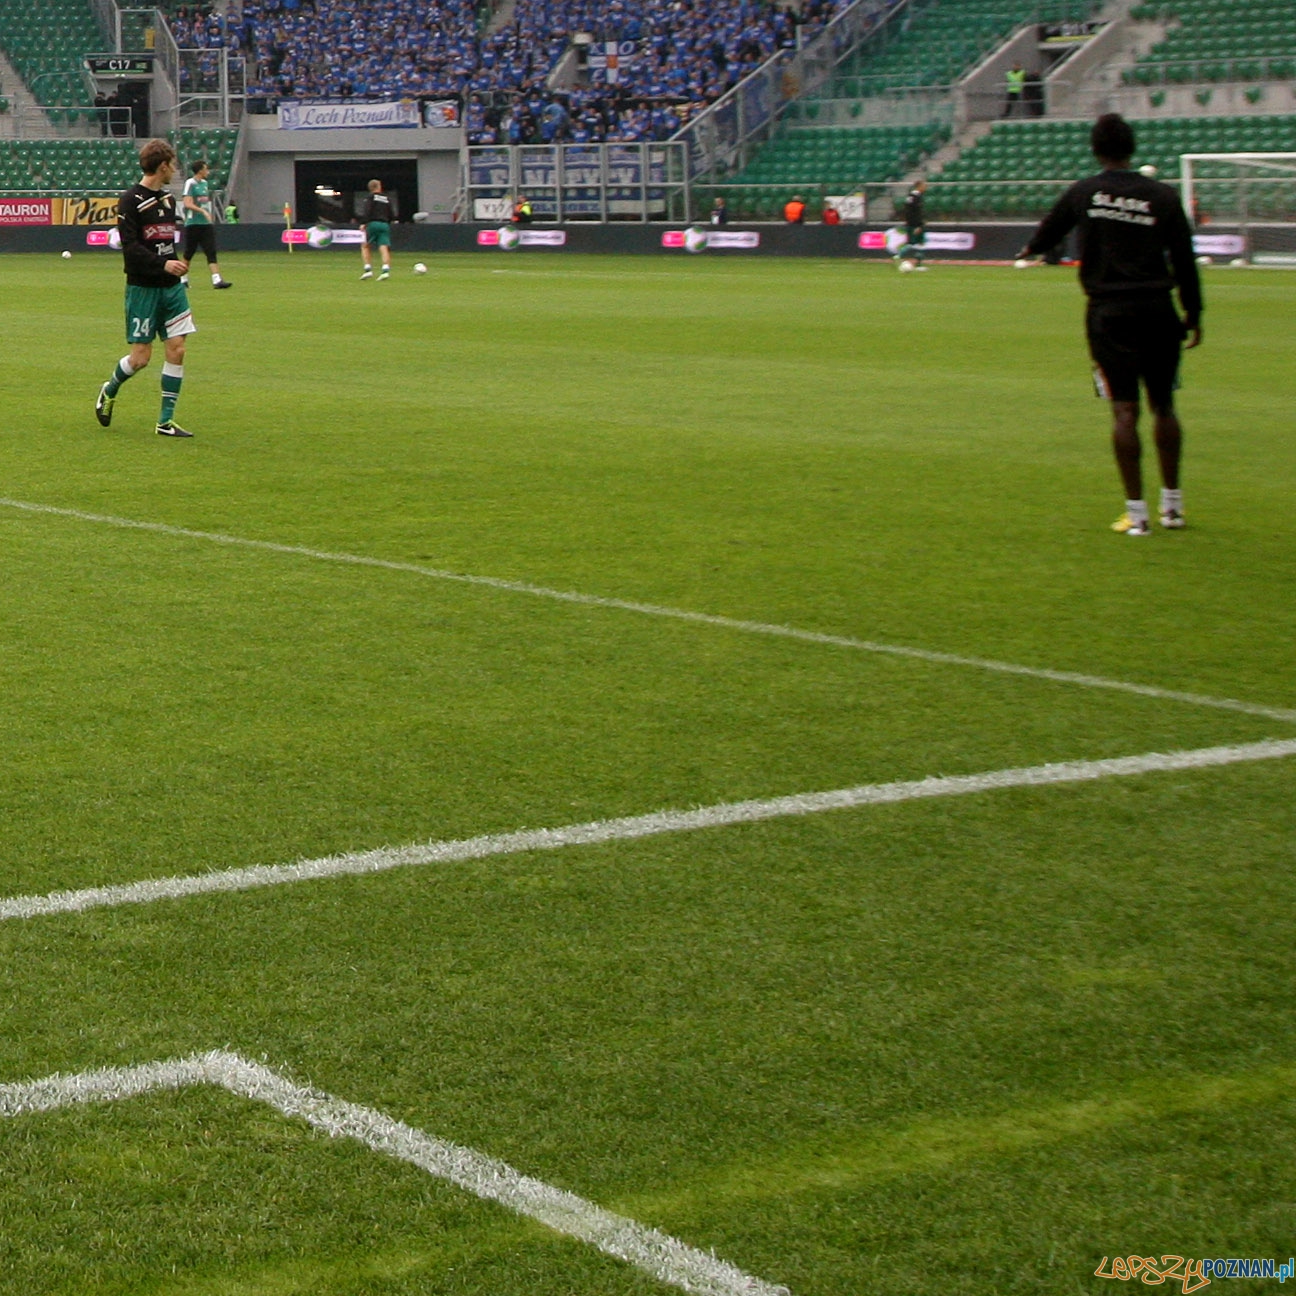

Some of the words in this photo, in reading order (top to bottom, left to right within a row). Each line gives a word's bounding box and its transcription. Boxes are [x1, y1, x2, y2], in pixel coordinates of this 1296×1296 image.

[109, 60, 130, 70] C17
[302, 108, 339, 126] Lech
[69, 198, 120, 225] Pias
[132, 317, 151, 338] 24
